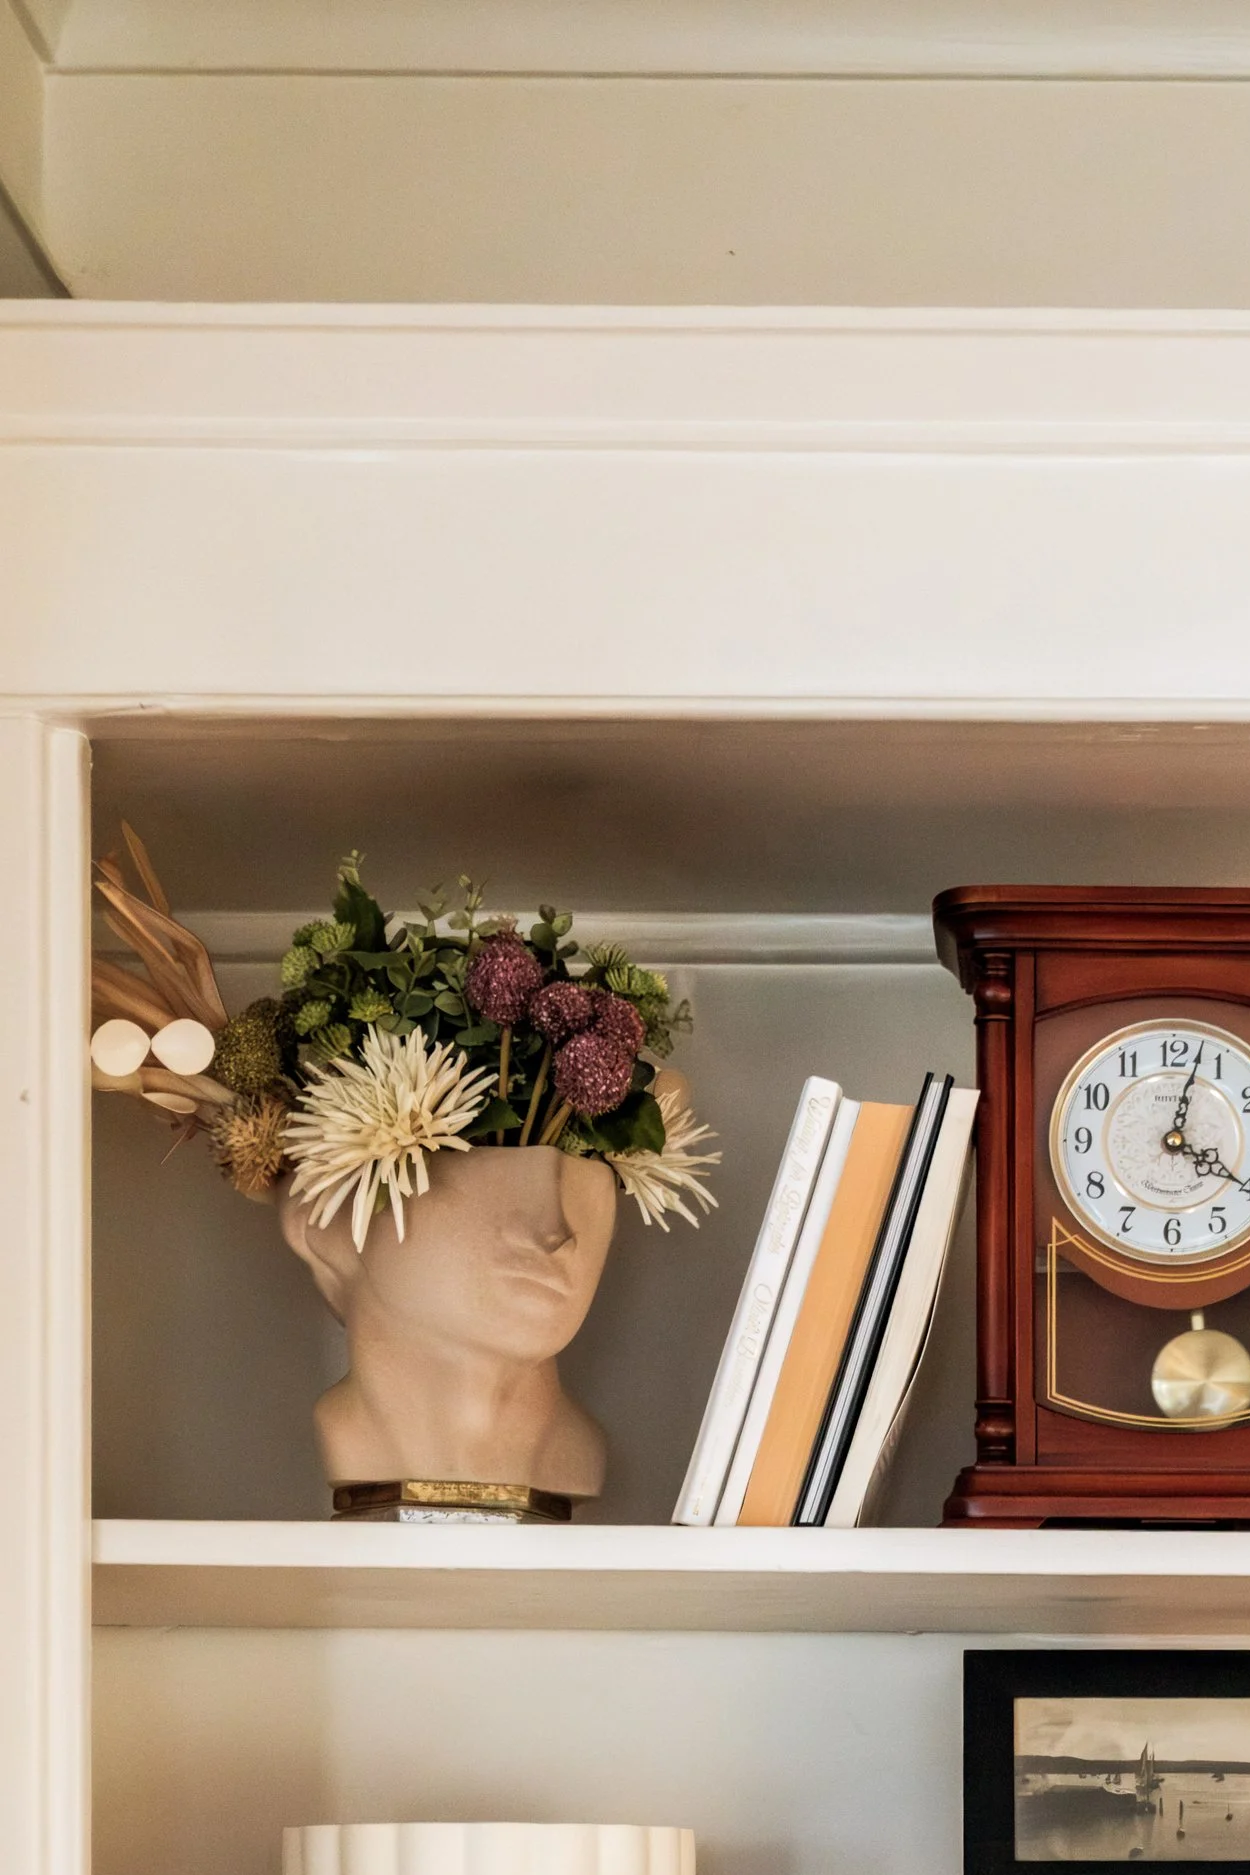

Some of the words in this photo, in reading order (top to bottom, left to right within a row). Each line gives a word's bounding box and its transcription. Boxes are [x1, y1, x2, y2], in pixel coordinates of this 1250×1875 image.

[1118, 1051, 1138, 1077] 11
[1160, 1040, 1188, 1067] 12
[1214, 1053, 1222, 1080] 1
[1084, 1082, 1110, 1111] 10
[1154, 1095, 1192, 1103] RHYT
[1074, 1127, 1092, 1153] 9
[1086, 1171, 1105, 1199] 8
[1118, 1206, 1136, 1233] 7
[1163, 1218, 1181, 1245] 6
[1208, 1206, 1226, 1234] 5
